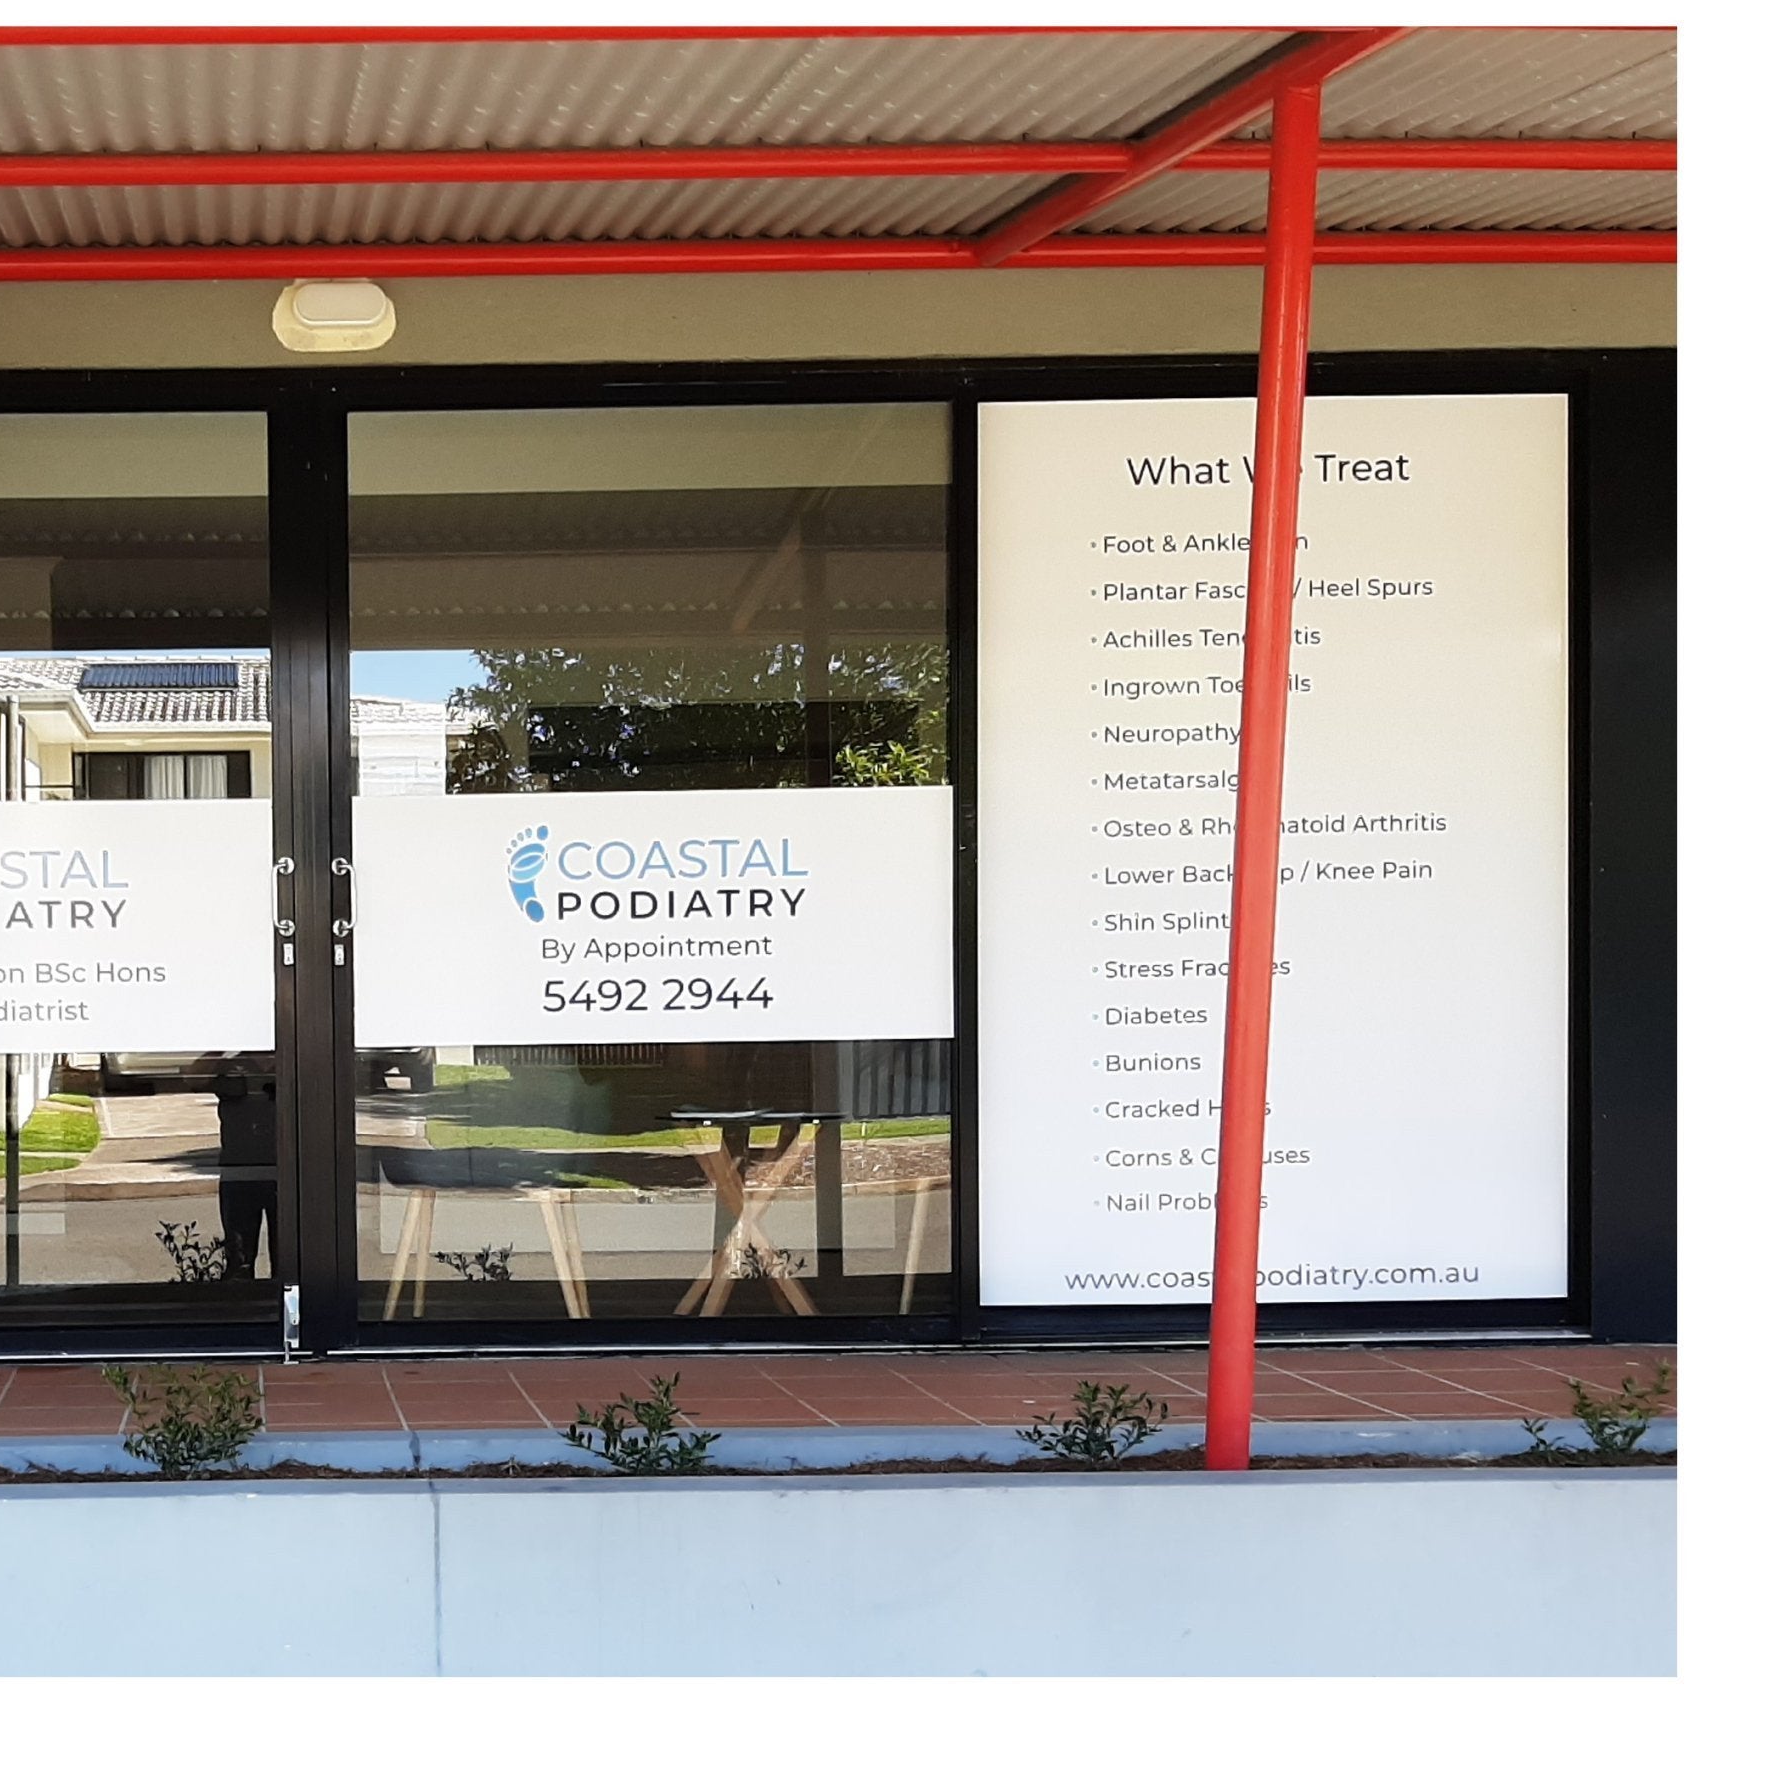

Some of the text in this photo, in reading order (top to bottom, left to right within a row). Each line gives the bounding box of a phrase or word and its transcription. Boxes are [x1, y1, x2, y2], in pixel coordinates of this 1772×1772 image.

[1127, 456, 1230, 486] What
[1315, 453, 1410, 483] Treat
[1103, 533, 1251, 554] Foot Ankle
[1103, 582, 1188, 602] Plantar
[1309, 579, 1359, 597] Heel
[1367, 578, 1433, 600] Spurs
[1103, 629, 1192, 649] Achilles
[1103, 676, 1244, 701] Ingrown Toe
[1104, 723, 1242, 747] Neuropathy
[1104, 813, 1447, 838] Osteo Arthritis
[558, 838, 809, 880] COASTAL
[1105, 861, 1433, 885] Lower Knee Pain
[558, 888, 806, 921] PODIATRY
[1105, 912, 1155, 932] Shin
[542, 936, 773, 964] By Appointment
[35, 963, 87, 984] BSc
[96, 962, 166, 983] Hons
[1105, 961, 1174, 979] Stress
[543, 976, 774, 1013] 5492 2944
[1106, 1006, 1208, 1025] Diabetes
[1106, 1053, 1201, 1073] Bunions
[1106, 1100, 1200, 1120] Cracked
[1106, 1148, 1172, 1168] Corns
[1108, 1193, 1150, 1213] Nail
